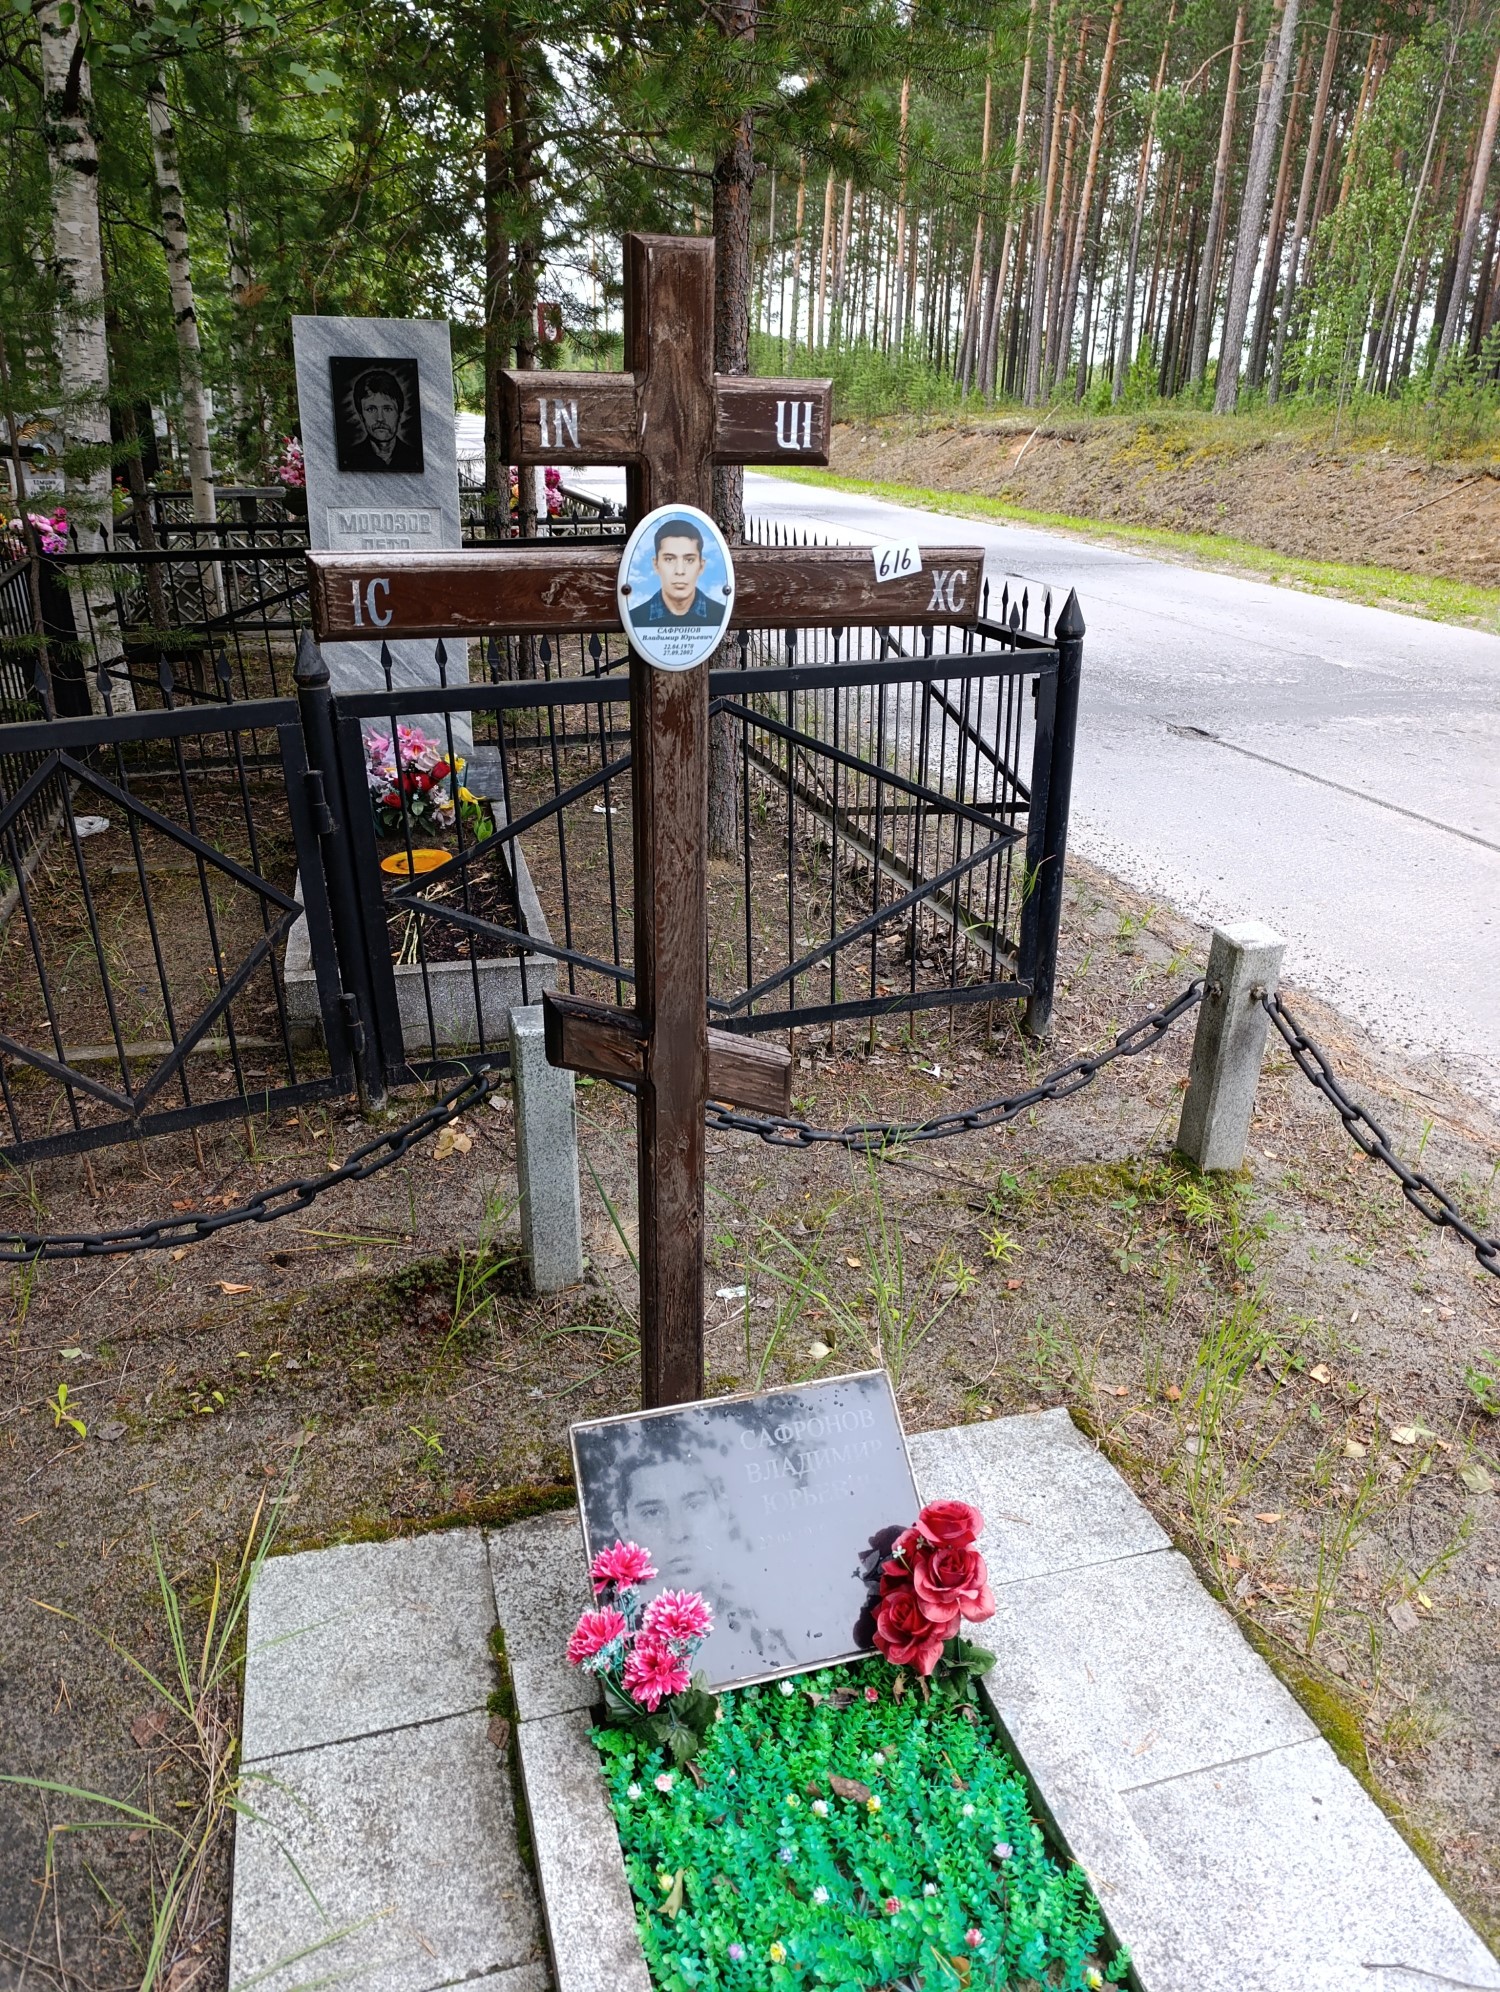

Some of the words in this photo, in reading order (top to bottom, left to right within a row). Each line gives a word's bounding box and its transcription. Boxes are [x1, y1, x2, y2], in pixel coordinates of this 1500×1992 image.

[339, 511, 432, 534] МОРОЗОВ
[879, 548, 911, 577] 616
[642, 634, 680, 642] Владимир
[680, 634, 713, 642] Юрьевич
[740, 1408, 875, 1450] САФРОНОВ
[744, 1439, 882, 1484] ВЛАДИМИР
